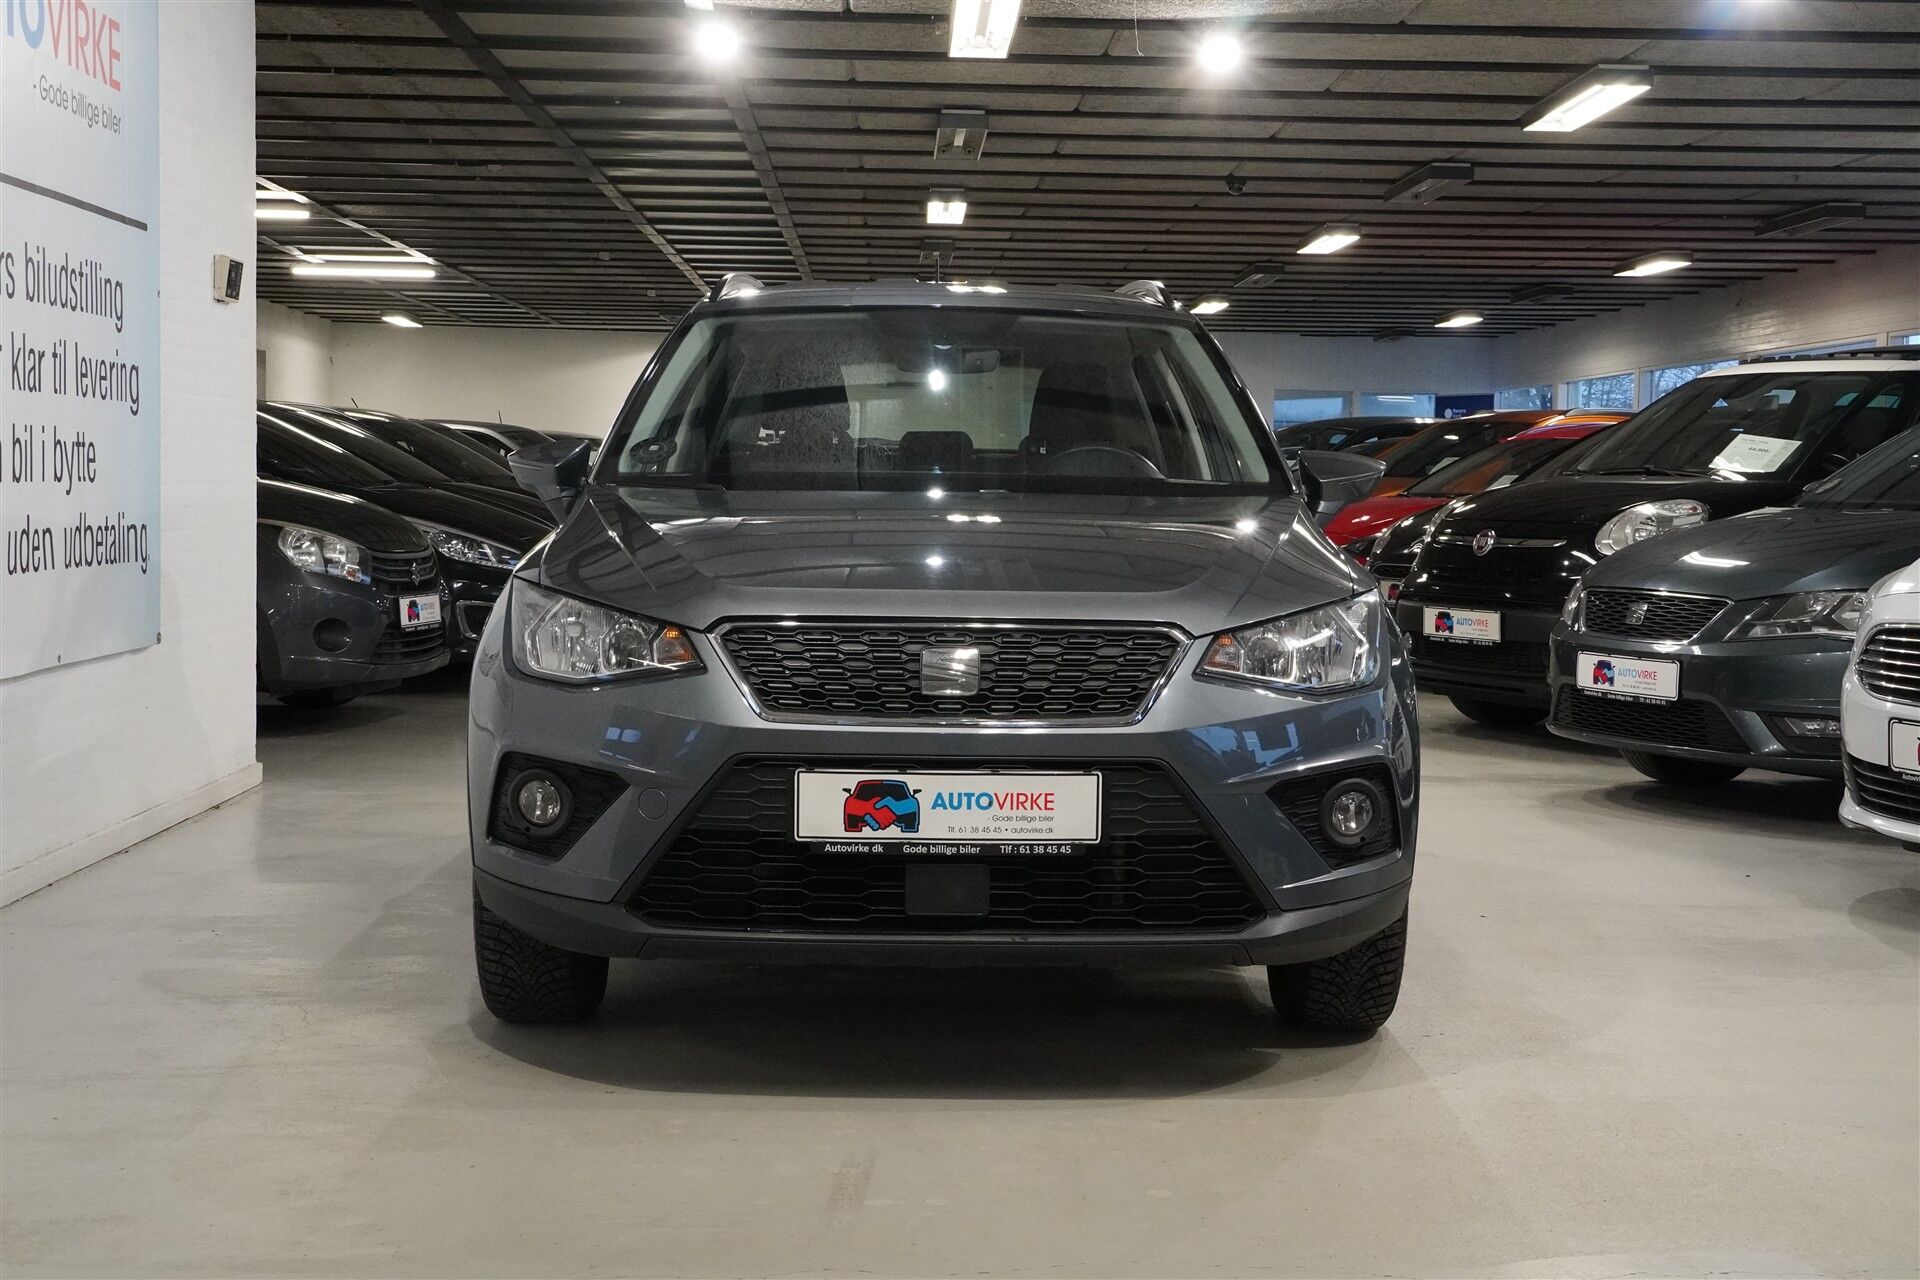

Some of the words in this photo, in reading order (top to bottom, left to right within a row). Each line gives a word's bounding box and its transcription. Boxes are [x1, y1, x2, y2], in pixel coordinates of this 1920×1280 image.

[39, 75, 69, 110] Gode
[71, 88, 100, 128] billige
[101, 103, 121, 135] biler
[25, 242, 123, 333] biludstilling
[11, 331, 46, 393] klar
[52, 339, 66, 395] til
[75, 342, 139, 416] levering
[12, 423, 33, 483] bil
[53, 425, 96, 495] bytte
[7, 515, 55, 575] uden
[1617, 668, 1658, 680] AUTOVIRKE
[931, 792, 1055, 811] AUTOVIRKE
[992, 814, 1014, 822] Gode
[1015, 814, 1037, 824] billige
[1039, 814, 1055, 822] biler
[824, 844, 869, 853] Autovirke
[903, 845, 928, 853] Gode
[930, 845, 957, 855] billige
[960, 845, 980, 854] biler
[1020, 845, 1031, 854] 61
[1033, 845, 1044, 854] 38
[1046, 845, 1058, 854] 45
[1060, 845, 1072, 854] 45
